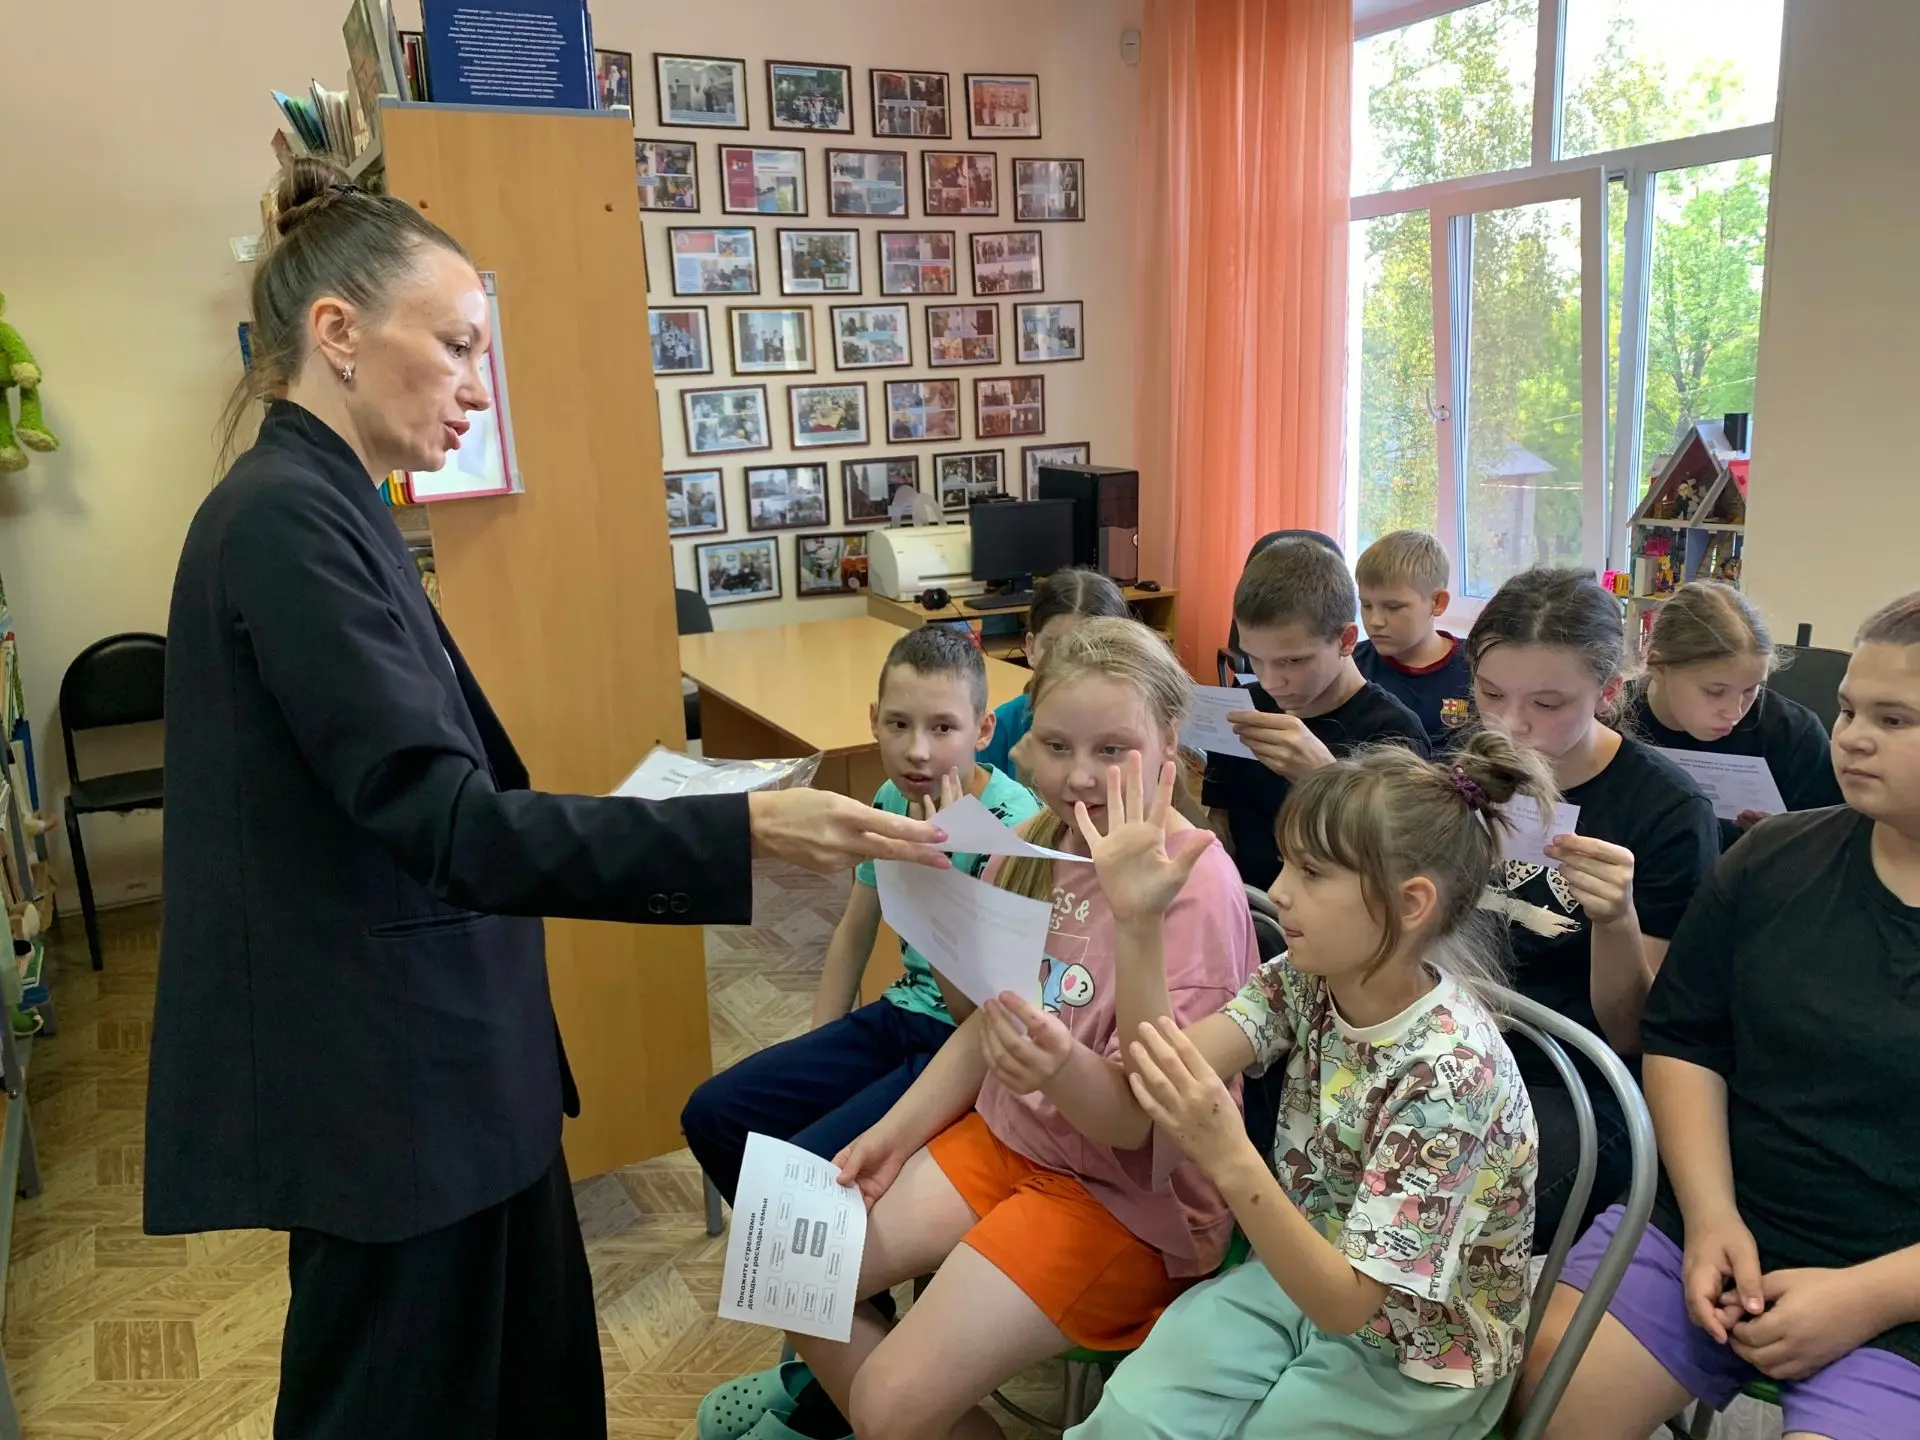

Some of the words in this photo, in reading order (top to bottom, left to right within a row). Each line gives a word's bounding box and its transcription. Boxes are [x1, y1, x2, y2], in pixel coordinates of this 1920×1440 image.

[1075, 899, 1090, 924] &
[737, 1263, 749, 1307] Покажите
[744, 1212, 756, 1261] стрелками
[747, 1276, 756, 1310] доходы
[753, 1228, 763, 1267] расходы
[759, 1198, 769, 1227] семьи
